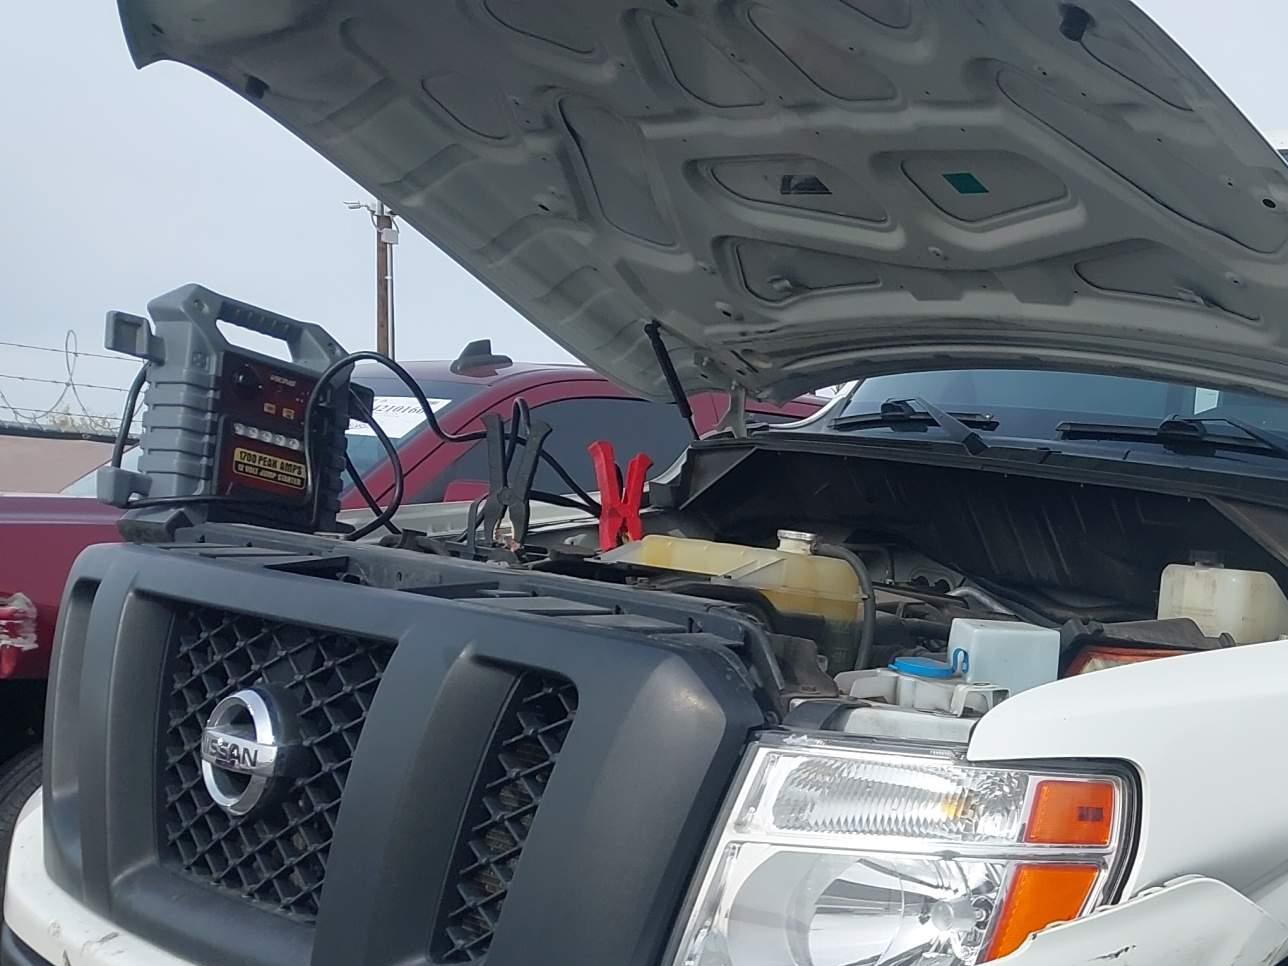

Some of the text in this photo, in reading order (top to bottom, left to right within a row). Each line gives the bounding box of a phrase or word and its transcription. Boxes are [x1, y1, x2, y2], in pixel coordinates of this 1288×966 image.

[258, 455, 277, 470] PEAK
[280, 460, 303, 476] AMPS
[202, 730, 259, 768] NISSAN
